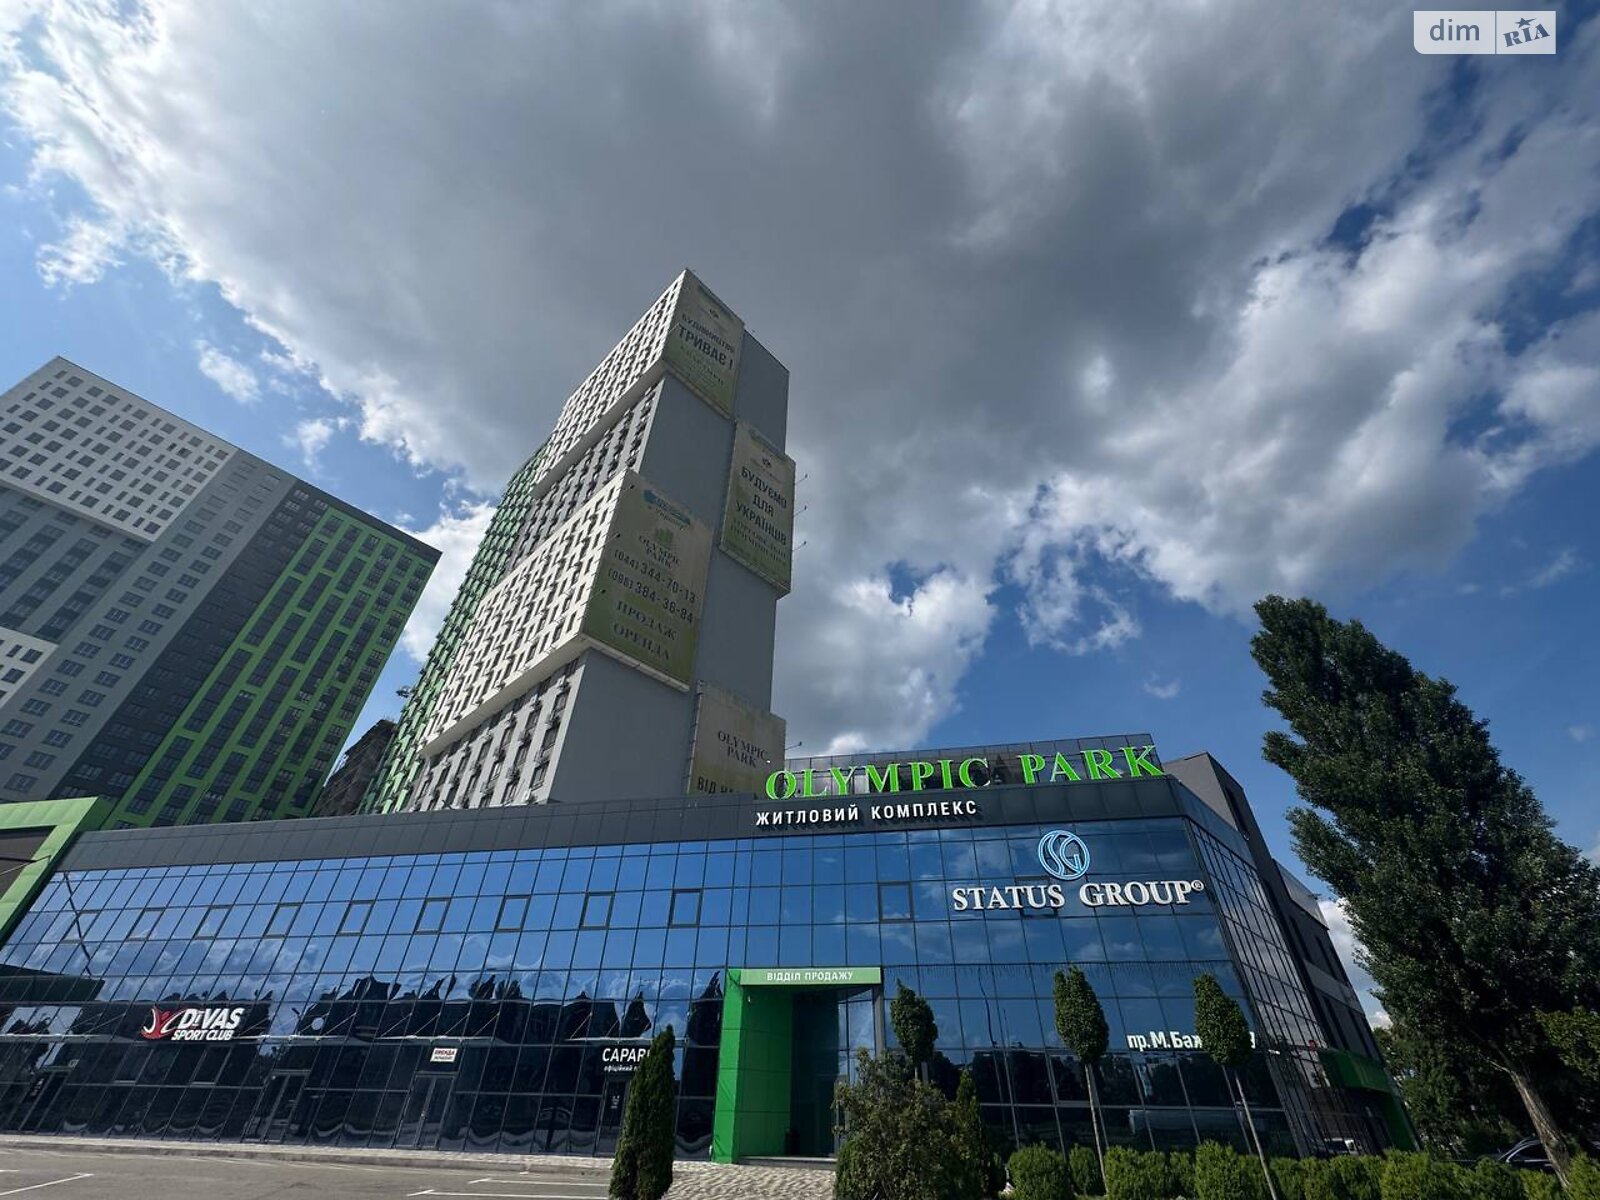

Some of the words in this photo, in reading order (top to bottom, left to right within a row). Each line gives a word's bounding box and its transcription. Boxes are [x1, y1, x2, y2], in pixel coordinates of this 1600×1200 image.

[741, 465, 787, 509] БУДУЄМО
[752, 494, 774, 517] ДЛЯ
[735, 501, 787, 546] УКРАЇНЦІВ
[616, 600, 677, 641] ПРОДАЖ
[717, 729, 768, 761] OLYMPIC
[727, 745, 757, 769] PARK
[765, 757, 992, 801] OLYMPIC
[1016, 744, 1165, 786] PARK
[755, 802, 860, 827] ЖИТЛОВИЙ
[871, 800, 979, 820] КОМПЛЕКС
[952, 883, 1066, 911] STATUS
[767, 971, 801, 981] ВІДДІЛ
[804, 970, 854, 981] ПРОДАЖУ
[170, 1029, 209, 1041] SPORT
[206, 1029, 235, 1041] CLUB
